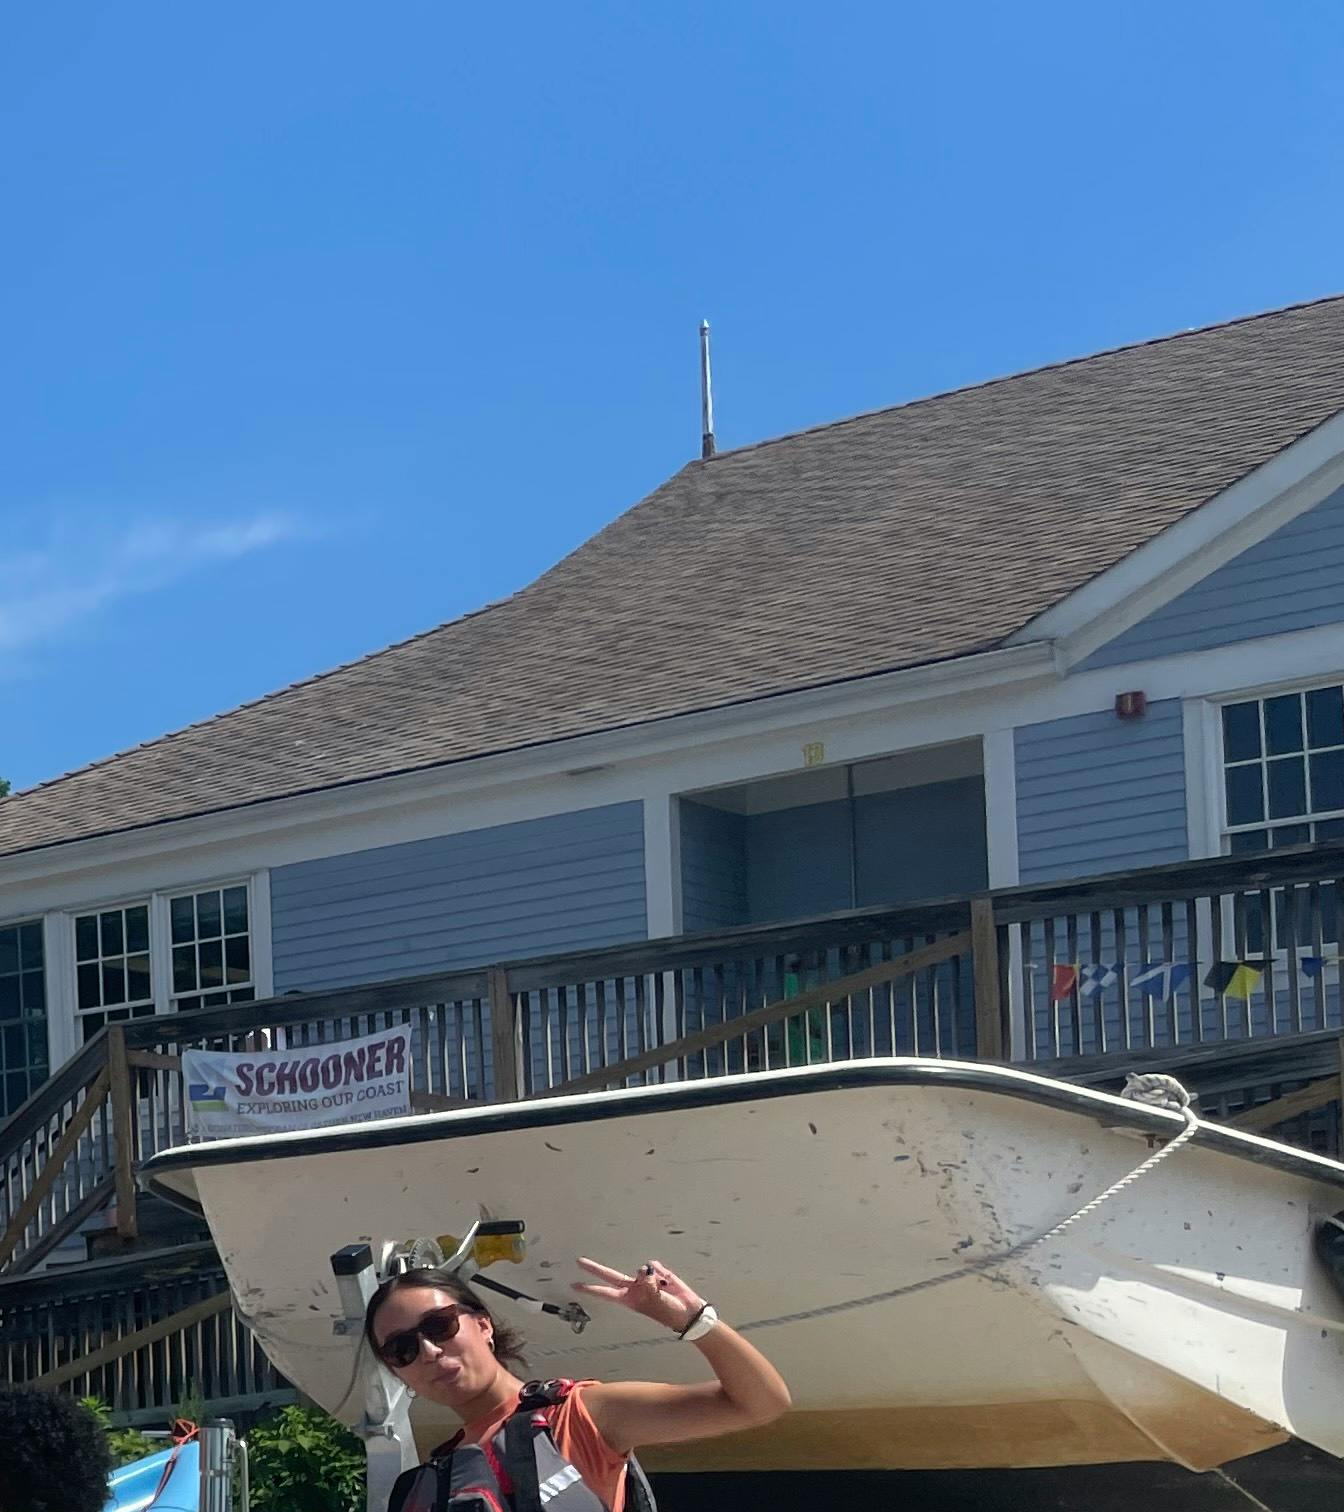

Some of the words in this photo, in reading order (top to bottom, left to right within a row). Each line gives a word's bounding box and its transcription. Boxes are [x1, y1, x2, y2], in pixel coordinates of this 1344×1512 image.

[234, 1035, 406, 1097] SCHOONER
[236, 1099, 318, 1116] EXPLORING
[321, 1093, 354, 1108] OUR
[356, 1080, 405, 1102] COAST
